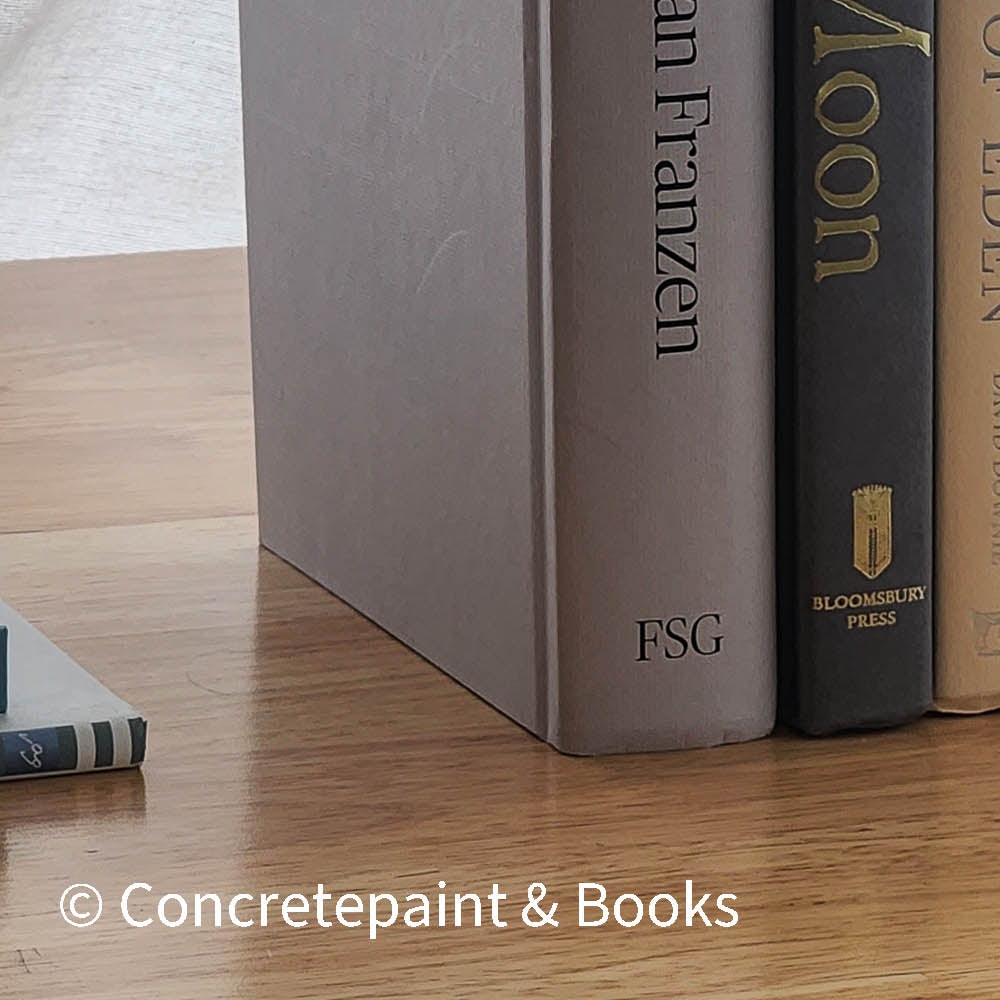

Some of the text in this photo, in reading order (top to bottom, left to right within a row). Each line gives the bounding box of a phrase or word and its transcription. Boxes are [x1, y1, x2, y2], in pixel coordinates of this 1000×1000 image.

[653, 85, 712, 361] Franzen
[812, 585, 927, 611] BLOOMSBURY
[634, 612, 725, 662] FSG
[847, 611, 897, 630] PRESS
